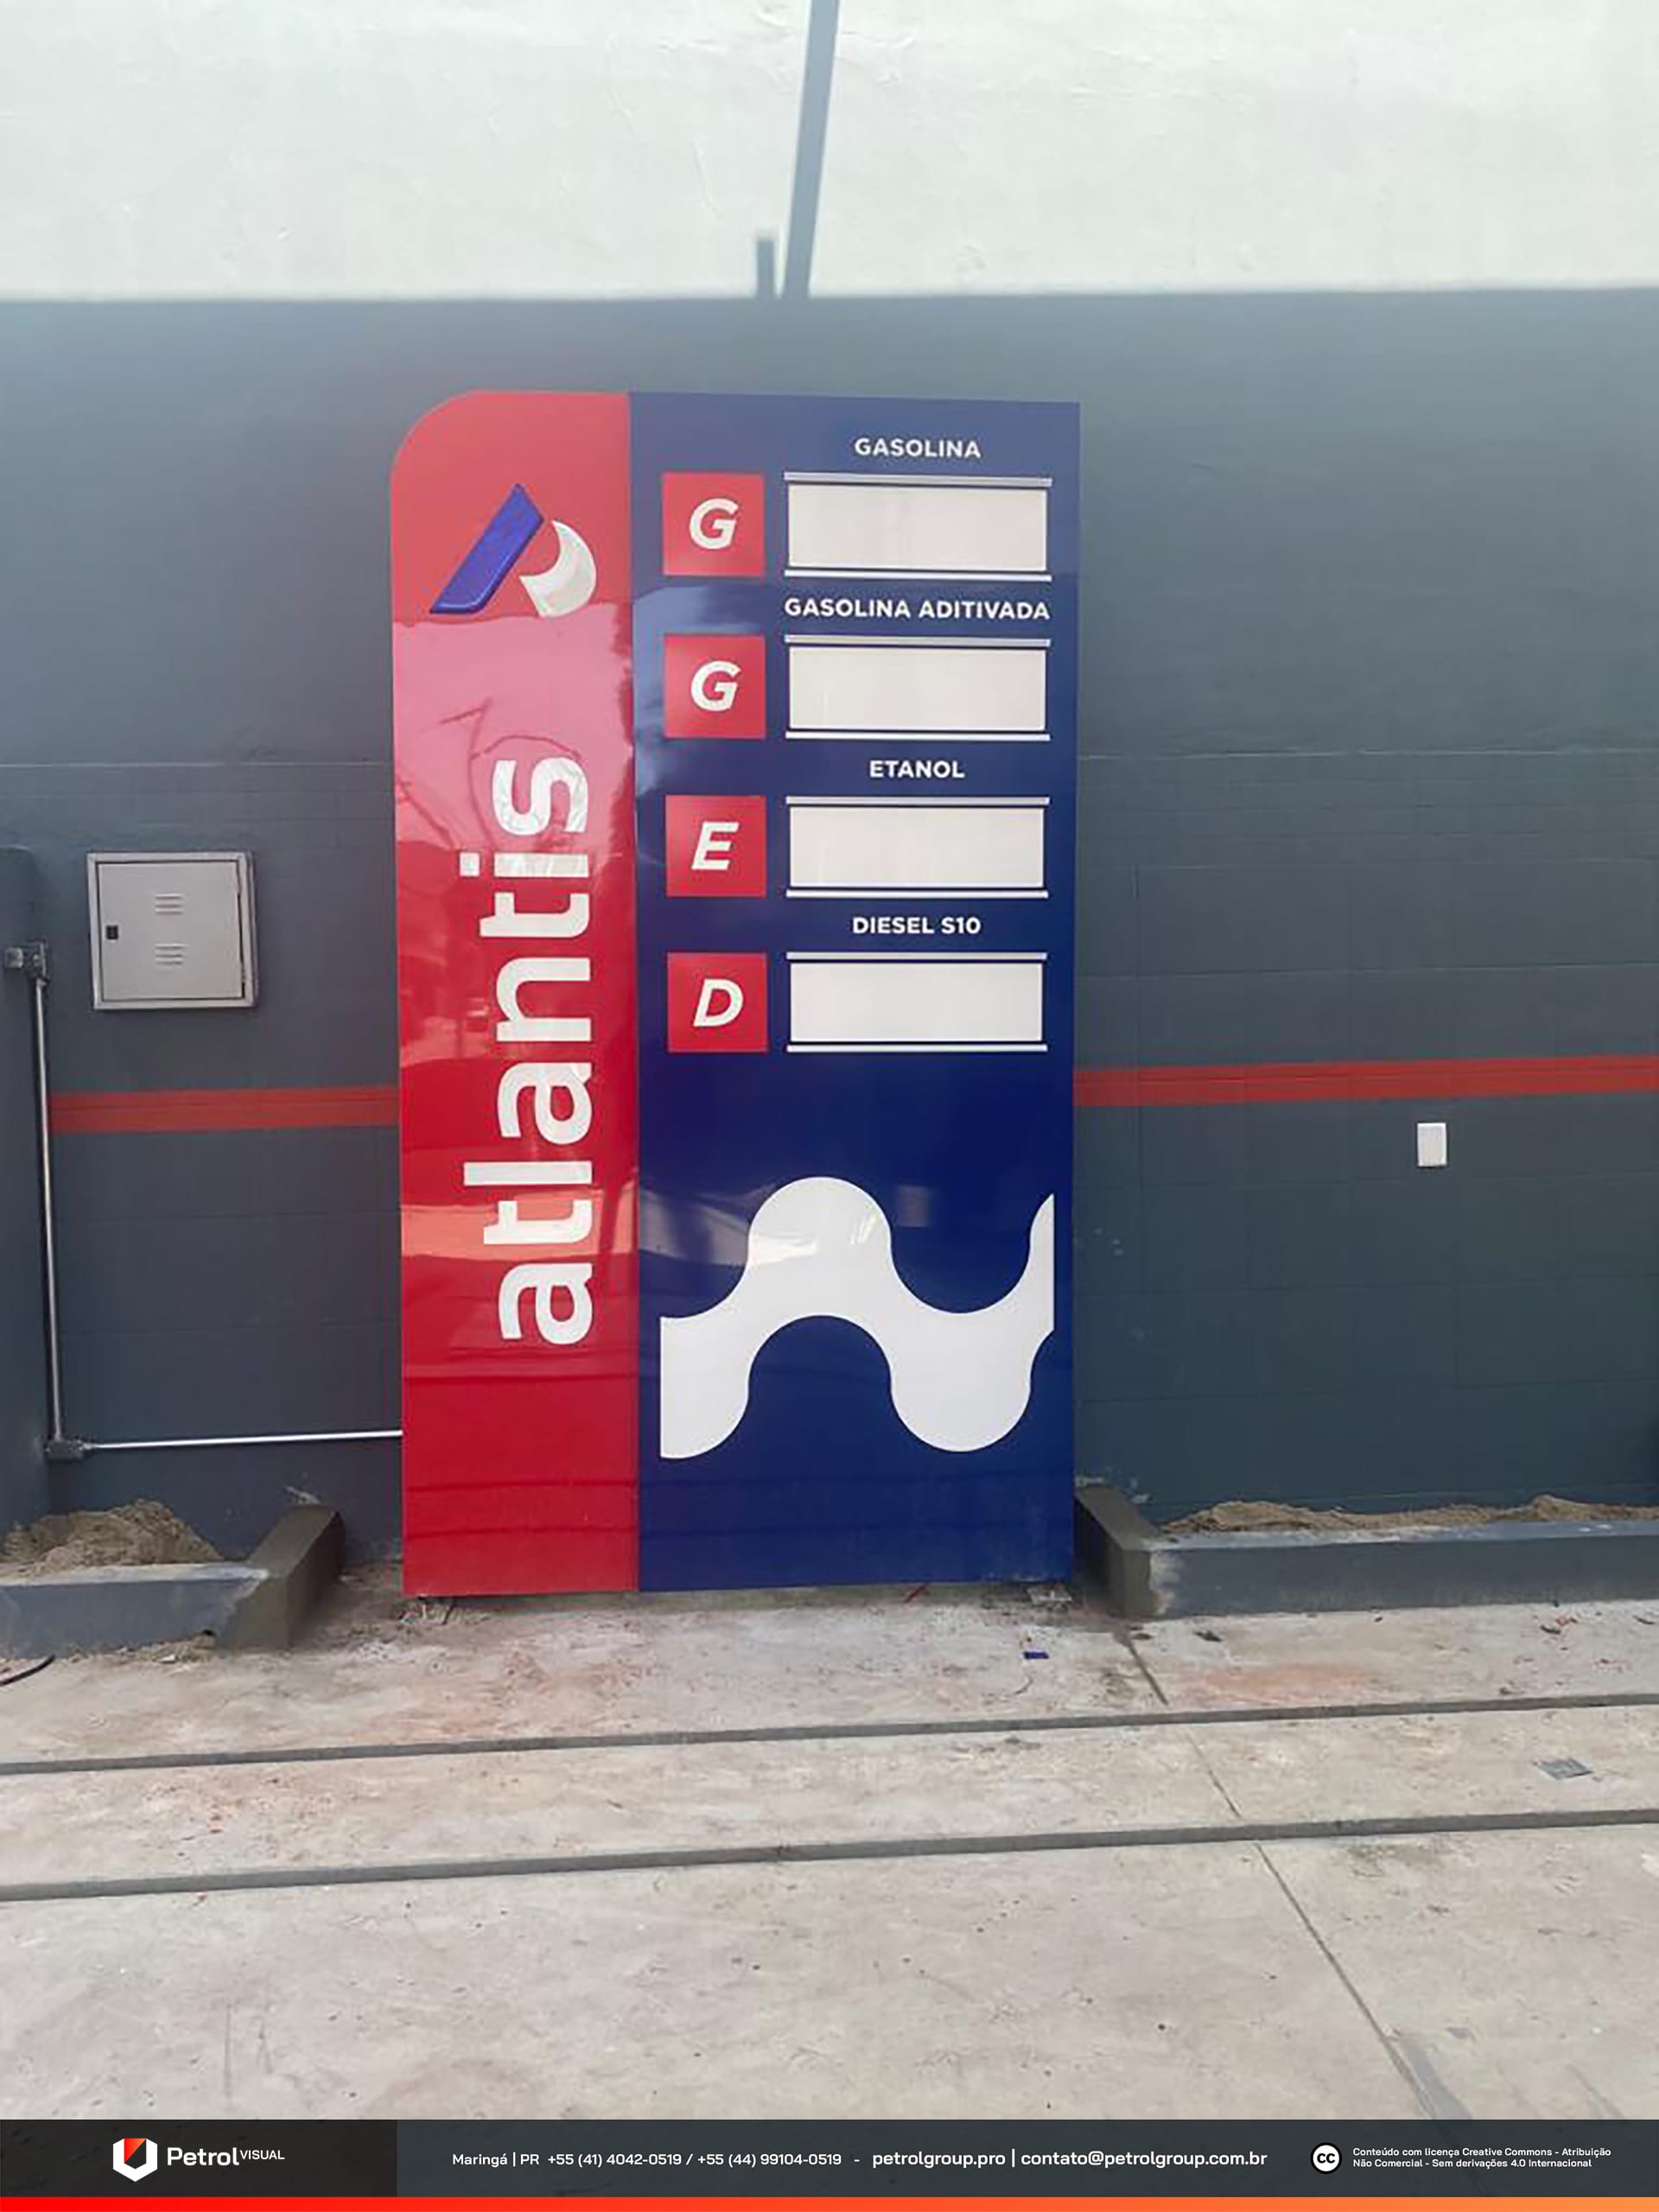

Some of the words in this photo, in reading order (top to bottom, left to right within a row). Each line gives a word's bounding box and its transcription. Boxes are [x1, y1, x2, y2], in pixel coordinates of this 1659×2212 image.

[854, 437, 982, 459] GASOLINA
[689, 498, 740, 550] G
[784, 597, 912, 619] GASOLINA
[918, 600, 1051, 620] ADITIVADA
[690, 659, 741, 712] G
[868, 759, 966, 779] ETANOL
[690, 820, 740, 871] E
[852, 916, 936, 935] DIESEL
[940, 916, 982, 935] S10
[693, 978, 744, 1027] D
[459, 756, 593, 1345] atlantis
